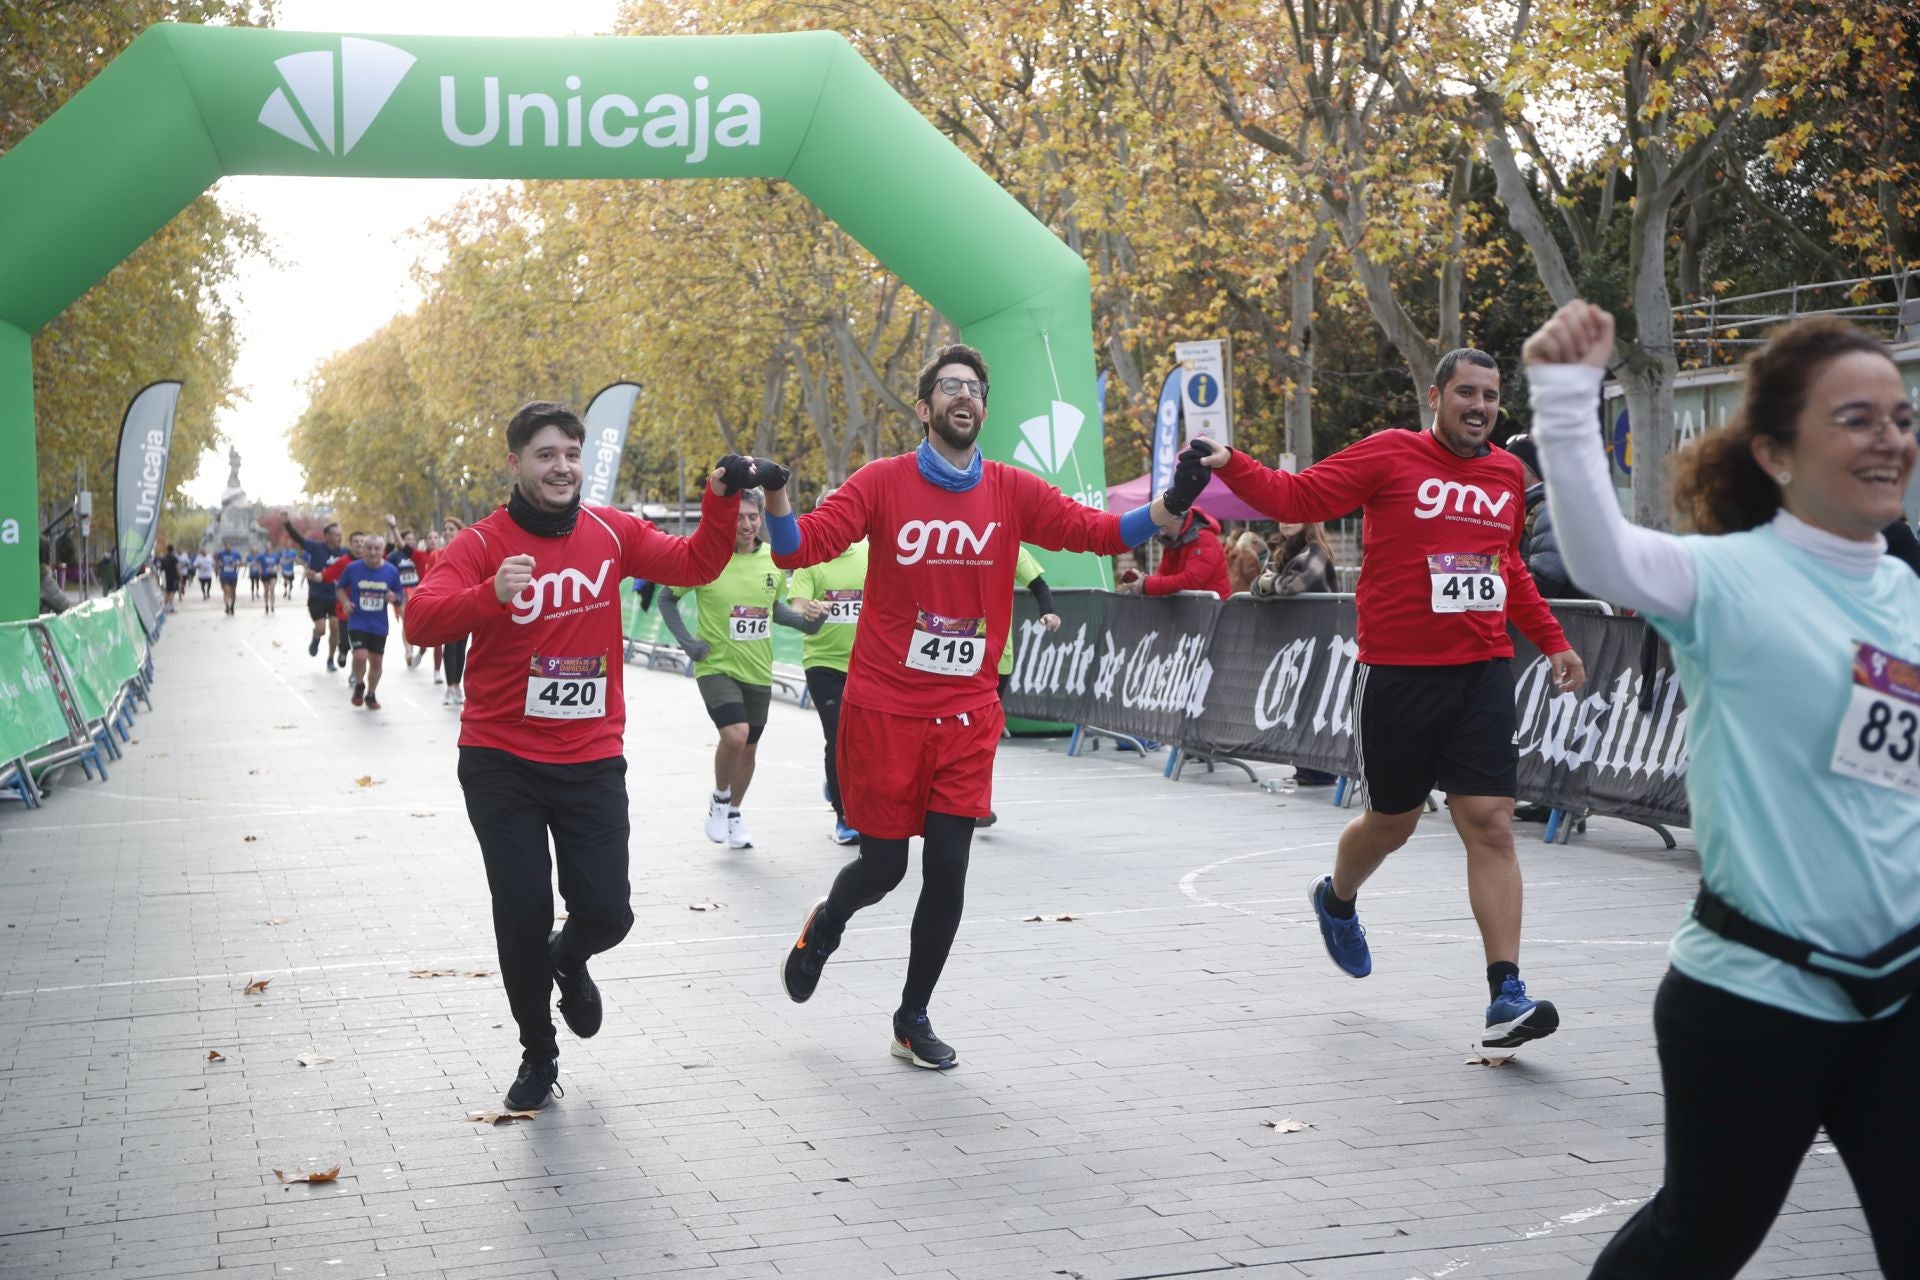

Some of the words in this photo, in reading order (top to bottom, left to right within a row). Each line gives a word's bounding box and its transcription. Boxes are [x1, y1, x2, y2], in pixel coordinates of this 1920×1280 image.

[440, 75, 761, 163] Unicaja
[136, 429, 167, 525] Unicaja
[1414, 478, 1511, 519] gmv
[1445, 514, 1481, 525] INNOVATING
[896, 519, 997, 566] gmv
[1443, 576, 1495, 600] 418
[544, 606, 584, 621] INNOVATING
[736, 620, 767, 634] 616
[830, 603, 860, 617] 615
[920, 637, 974, 664] 419
[1010, 619, 1095, 696] Norte
[1094, 630, 1126, 702] de
[1123, 630, 1214, 719] Castilla
[1255, 636, 1316, 731] El
[538, 681, 596, 706] 420
[1859, 700, 1920, 767] 83
